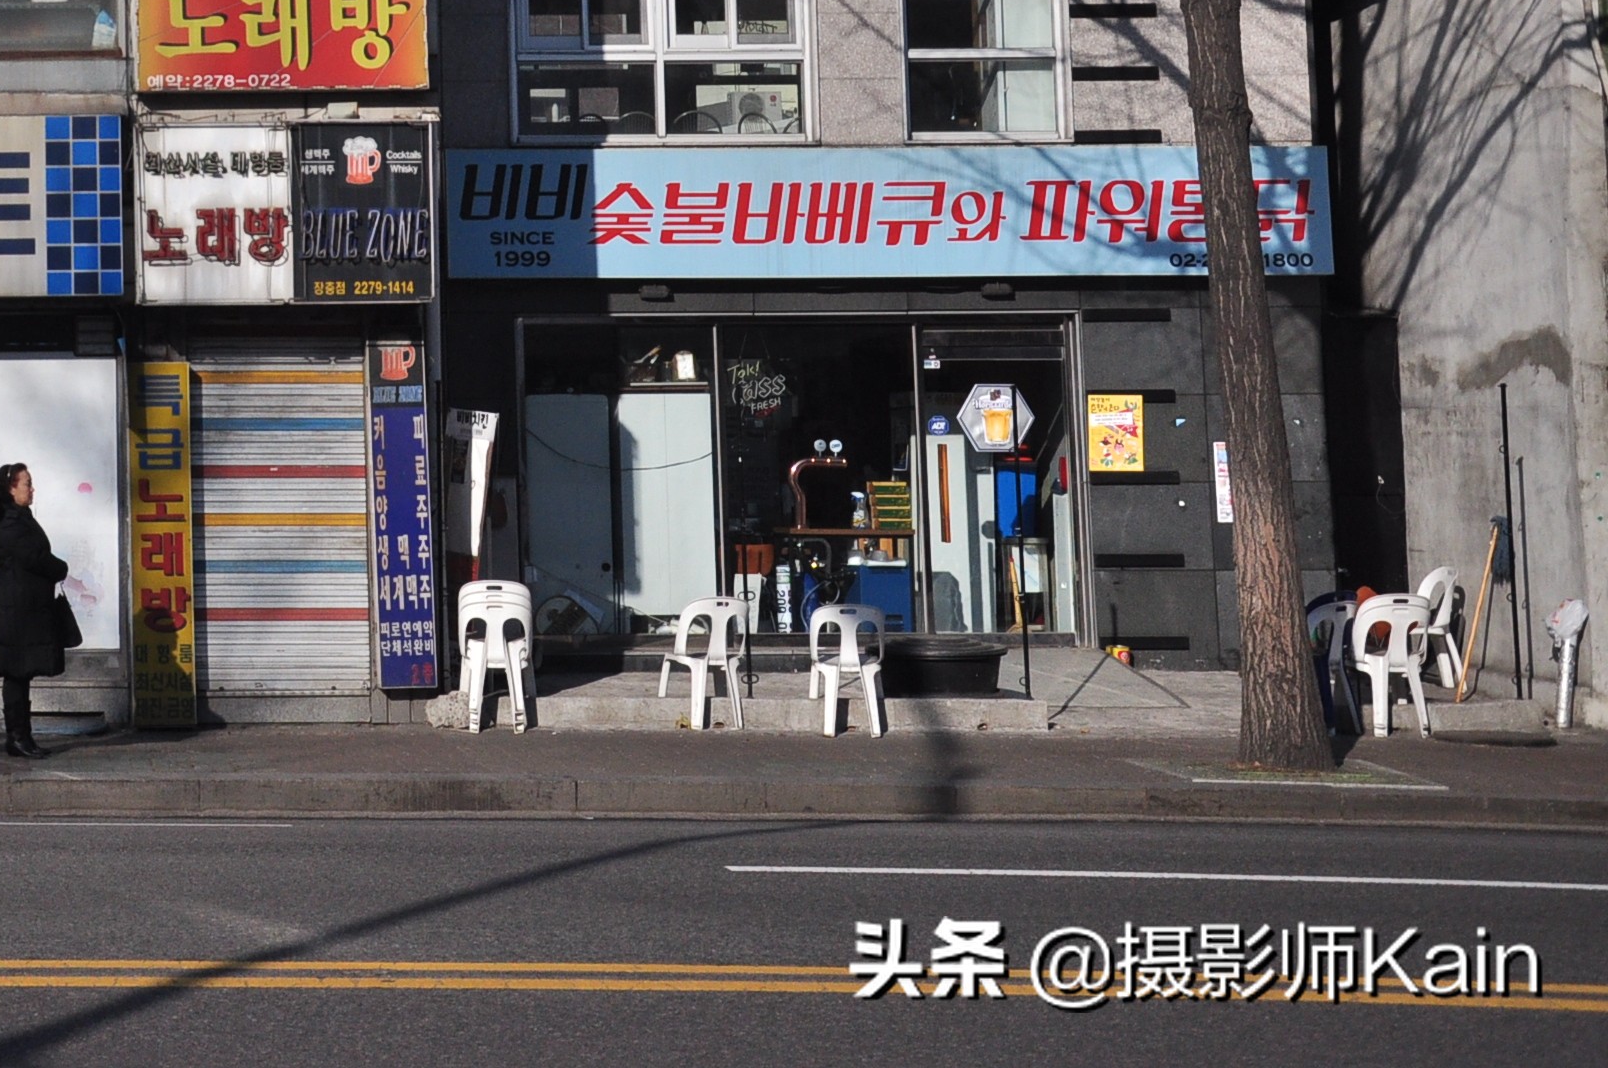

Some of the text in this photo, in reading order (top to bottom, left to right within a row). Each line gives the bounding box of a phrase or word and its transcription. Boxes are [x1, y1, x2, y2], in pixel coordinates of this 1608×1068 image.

[385, 150, 422, 160] Cocktails
[390, 164, 419, 175] Whisky
[459, 163, 589, 222] 비비
[588, 180, 1007, 247] 숯불바베큐와
[143, 207, 289, 263] 노래방
[302, 207, 429, 263] BLUE ZONE
[489, 231, 555, 245] SINCE
[493, 250, 551, 267] 1999
[135, 374, 185, 470] 특급
[931, 421, 946, 430] ADT
[135, 478, 192, 632] 노래방
[378, 534, 430, 570] 생맥주
[380, 575, 432, 611] 세계맥주
